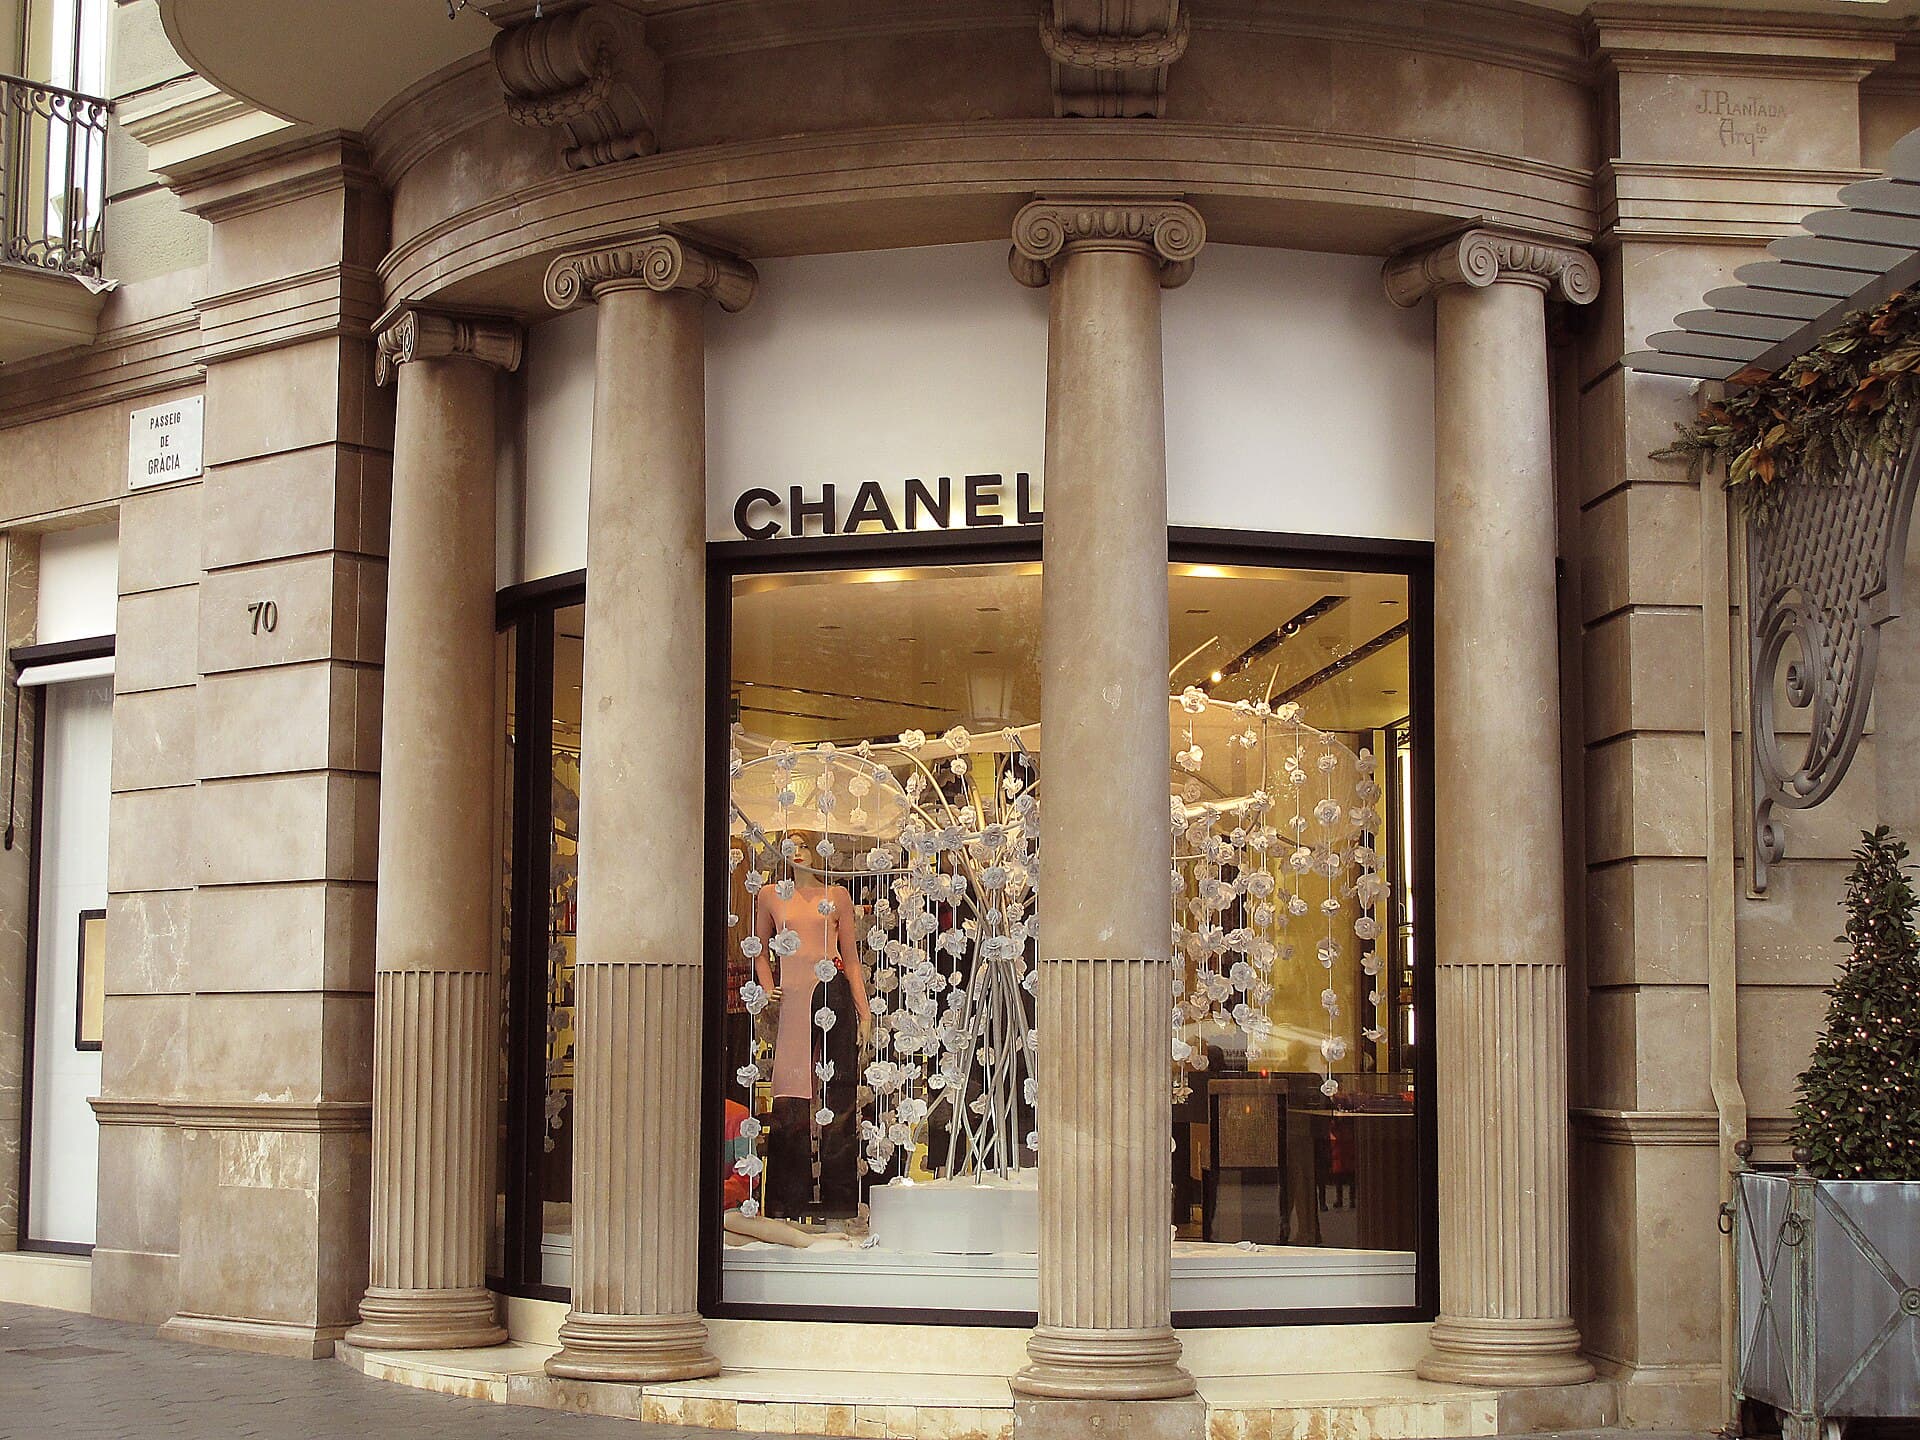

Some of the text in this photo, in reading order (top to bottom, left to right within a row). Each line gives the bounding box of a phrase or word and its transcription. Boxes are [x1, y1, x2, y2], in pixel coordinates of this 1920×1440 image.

[149, 411, 181, 430] PASSEIG
[160, 434, 170, 448] DE
[147, 452, 180, 475] GRÀCIA
[733, 472, 1044, 540] CHANEL
[247, 601, 278, 636] 70
